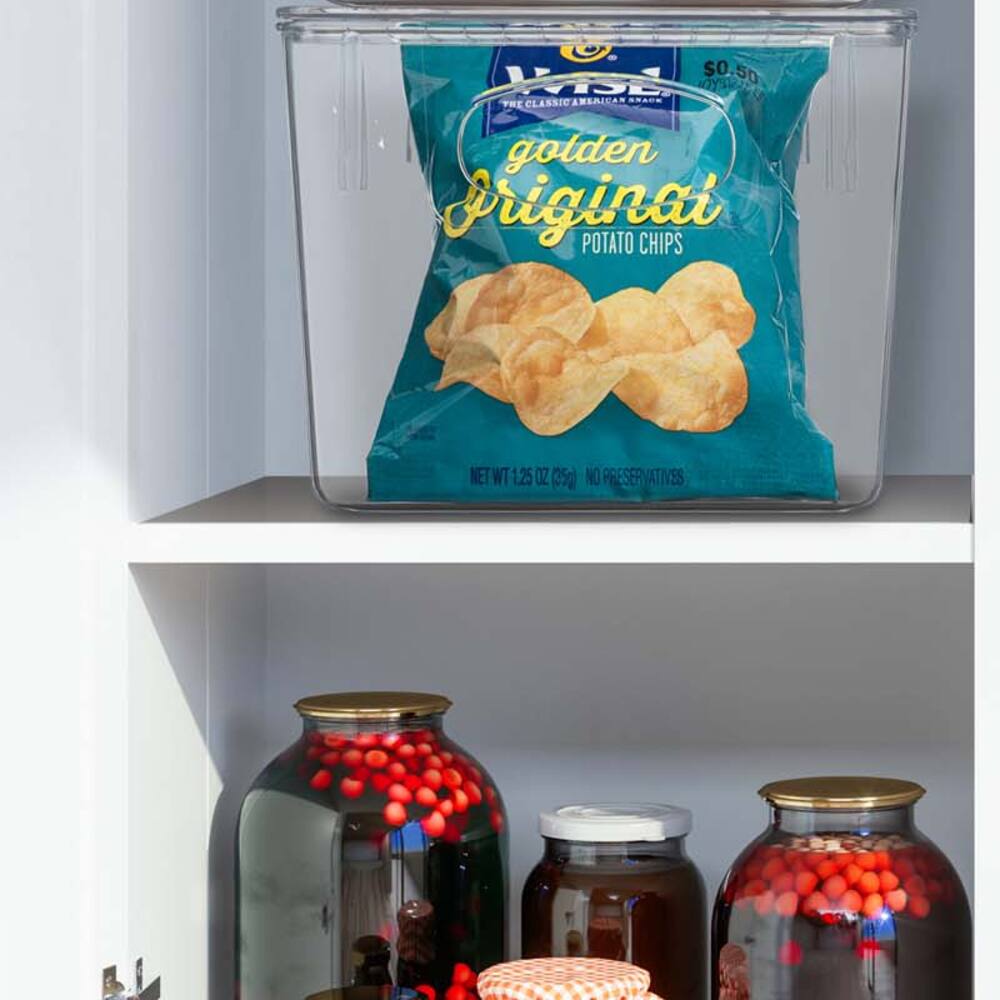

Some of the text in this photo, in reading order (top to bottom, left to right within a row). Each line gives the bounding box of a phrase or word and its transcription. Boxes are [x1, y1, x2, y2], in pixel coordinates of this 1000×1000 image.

[704, 60, 759, 85] $0.50
[502, 100, 522, 109] THE
[525, 99, 569, 108] CLASSIC
[571, 97, 625, 107] AMERICAN
[504, 134, 658, 175] golden
[582, 232, 683, 255] POTATO CHIPS
[470, 467, 489, 486] NET
[513, 467, 532, 486] 1.25
[537, 467, 549, 486] OZ
[586, 467, 600, 486] NO
[603, 467, 685, 486] PRESERVATIVES
